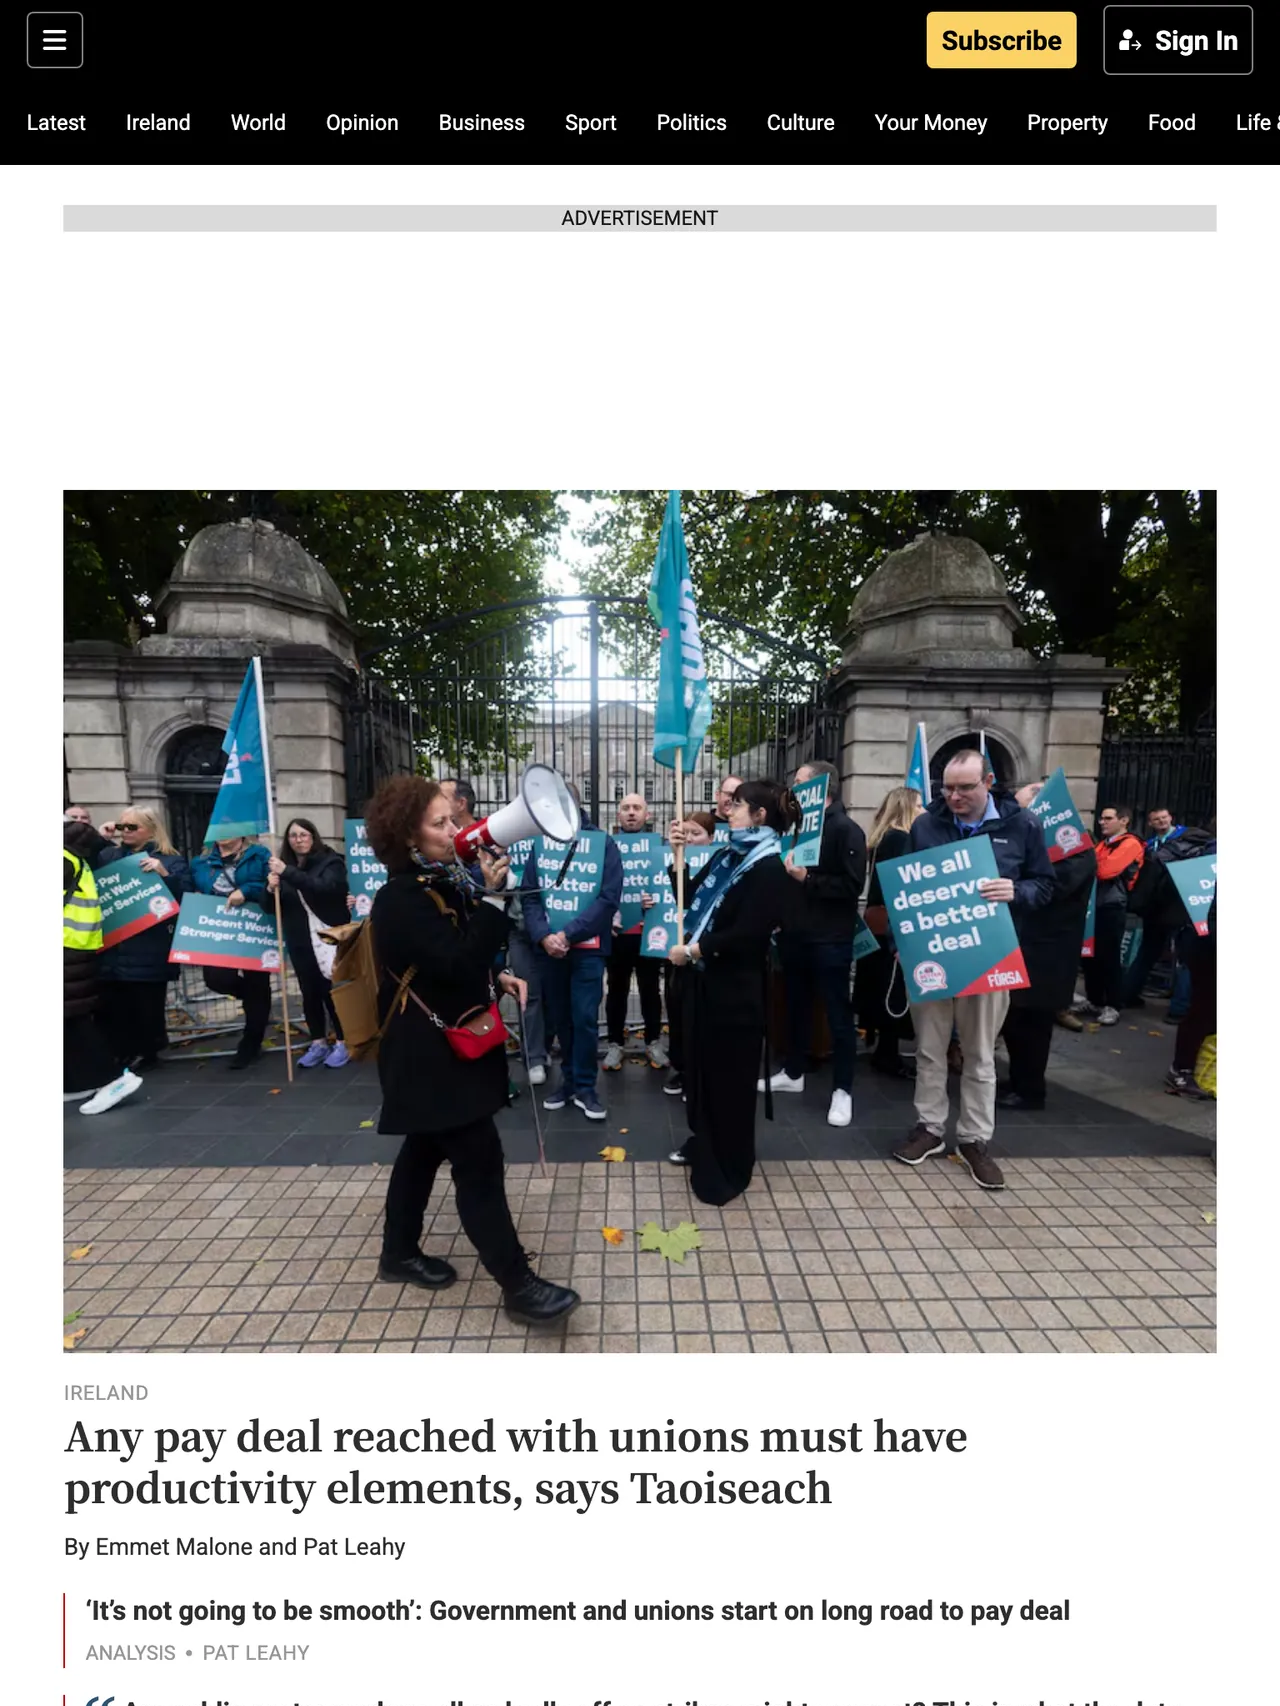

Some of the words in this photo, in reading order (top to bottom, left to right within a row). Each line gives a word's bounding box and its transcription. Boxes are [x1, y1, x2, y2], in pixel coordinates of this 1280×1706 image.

[942, 29, 1062, 51] Subscribe
[1156, 30, 1208, 56] Sign
[1217, 30, 1238, 50] In
[28, 114, 86, 131] Latest
[127, 113, 190, 131] Ireland
[231, 113, 285, 131] World
[327, 114, 398, 135] Opinion
[440, 114, 525, 131] Business
[566, 114, 617, 135] Sport
[658, 113, 727, 131] Politics
[767, 113, 834, 131] Culture
[875, 114, 919, 131] Your
[925, 114, 988, 135] Money
[1028, 114, 1108, 135] Property
[1149, 113, 1195, 131] Food
[1237, 113, 1271, 131] Life
[561, 210, 718, 225] ADVERTISEMENT
[632, 839, 649, 853] all
[537, 853, 598, 873] desrve
[897, 861, 937, 884] We
[941, 849, 972, 874] all
[98, 873, 120, 888] Pay
[110, 877, 142, 896] Work
[113, 883, 163, 910] Services
[546, 894, 579, 911] deal
[241, 908, 263, 921] Pay
[900, 919, 915, 934] a
[916, 901, 999, 931] better
[179, 926, 236, 942] Stronger
[198, 915, 243, 930] Decent
[245, 921, 275, 934] Work
[928, 926, 982, 954] deal
[987, 969, 1024, 988] FÓRSA
[66, 1385, 148, 1400] IRELAND
[64, 1421, 144, 1463] Any
[154, 1429, 227, 1463] pay
[237, 1418, 322, 1452] deal
[334, 1418, 496, 1453] reached
[506, 1418, 598, 1452] with
[609, 1419, 749, 1453] unions
[760, 1423, 863, 1452] must
[874, 1418, 967, 1452] have
[65, 1470, 317, 1514] productivity
[327, 1470, 522, 1511] elements,
[536, 1480, 619, 1514] says
[630, 1470, 832, 1504] Taoiseach
[65, 1538, 89, 1560] By
[97, 1538, 169, 1555] Emmet
[177, 1537, 252, 1555] Malone
[259, 1537, 296, 1555] and
[305, 1538, 338, 1555] Pat
[345, 1537, 405, 1560] Leahy
[134, 1602, 172, 1620] not
[179, 1600, 245, 1626] going
[252, 1602, 276, 1620] to
[284, 1599, 312, 1620] be
[430, 1600, 576, 1620] Government
[583, 1599, 626, 1620] and
[635, 1600, 714, 1620] unions
[721, 1602, 777, 1620] start
[785, 1605, 813, 1620] on
[822, 1599, 872, 1626] long
[881, 1599, 932, 1620] road
[940, 1602, 963, 1620] to
[971, 1605, 1013, 1626] pay
[1020, 1599, 1069, 1620] deal
[86, 1645, 175, 1660] ANALYSIS
[204, 1645, 239, 1660] PAT
[247, 1645, 309, 1660] LEAHY
